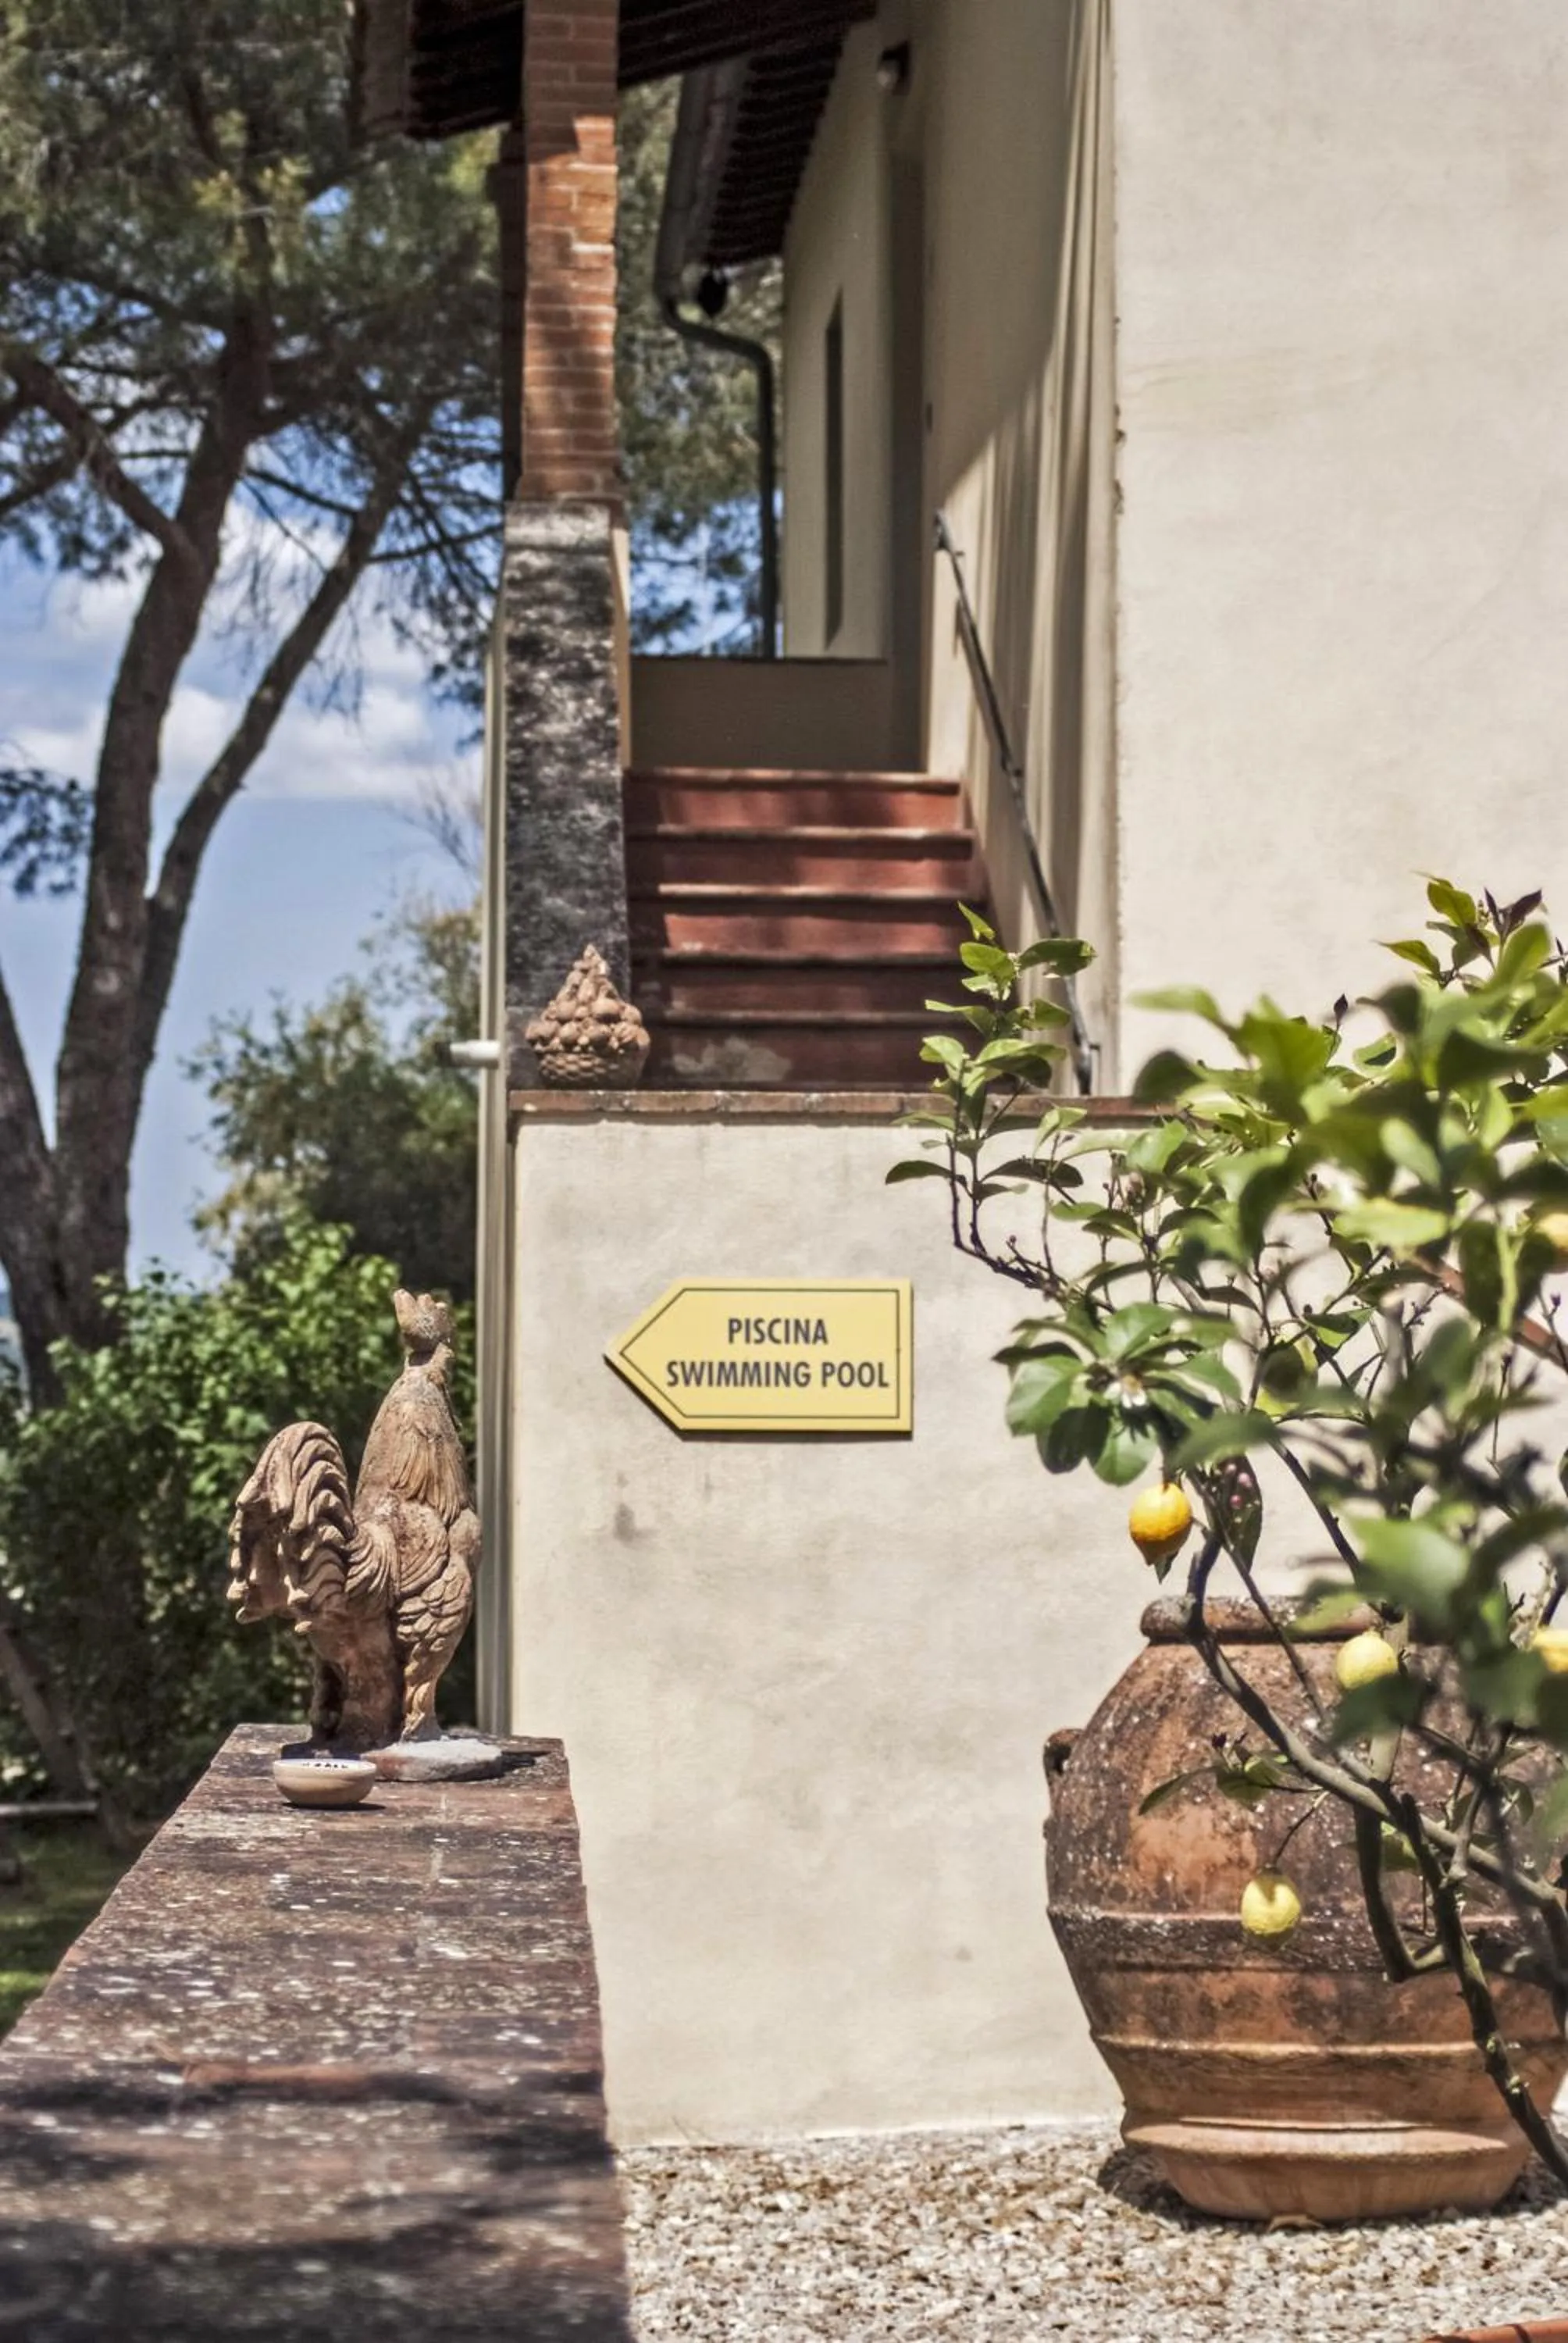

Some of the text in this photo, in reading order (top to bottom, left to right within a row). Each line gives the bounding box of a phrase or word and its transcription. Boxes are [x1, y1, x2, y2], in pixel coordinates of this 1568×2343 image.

[728, 1318, 828, 1344] PISCINA
[667, 1361, 889, 1388] SWIMMING POOL
